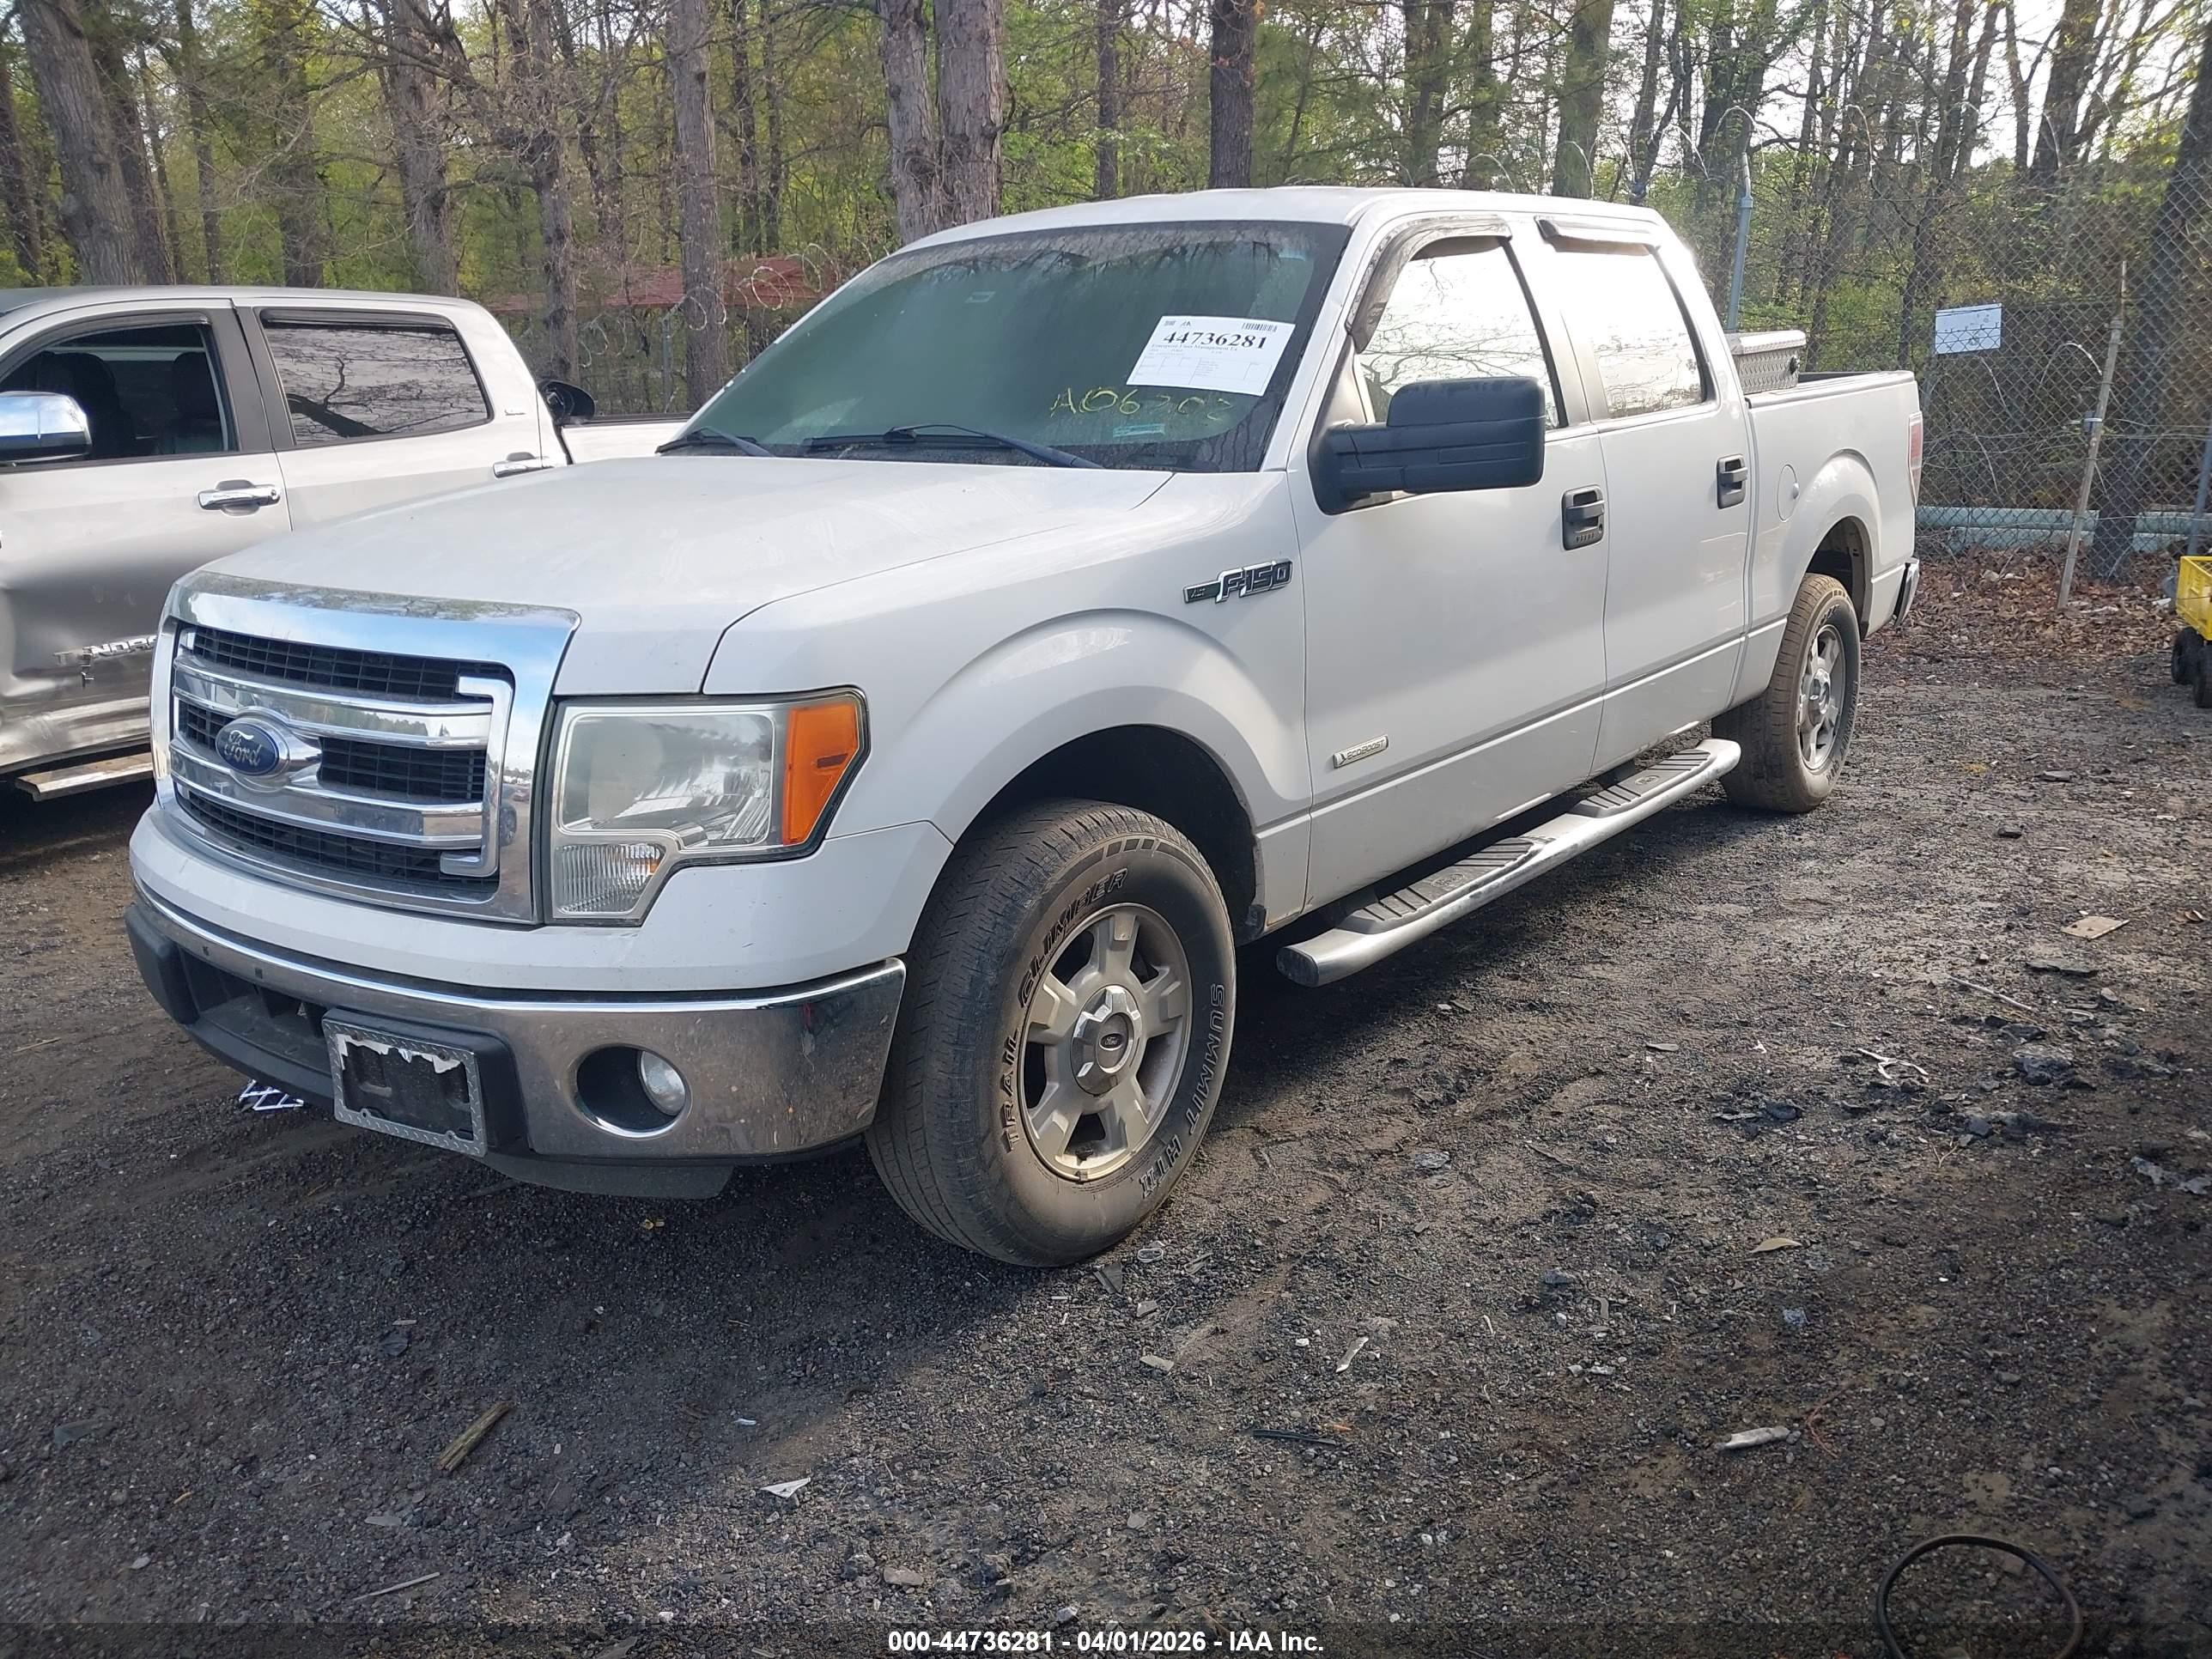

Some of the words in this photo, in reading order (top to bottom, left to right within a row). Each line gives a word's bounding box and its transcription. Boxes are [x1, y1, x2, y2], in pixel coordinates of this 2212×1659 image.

[1163, 331, 1267, 349] 44736281
[224, 729, 263, 766] Ford
[998, 1028, 1023, 1154] TRAIL
[1187, 982, 1226, 1135] SUMMIT
